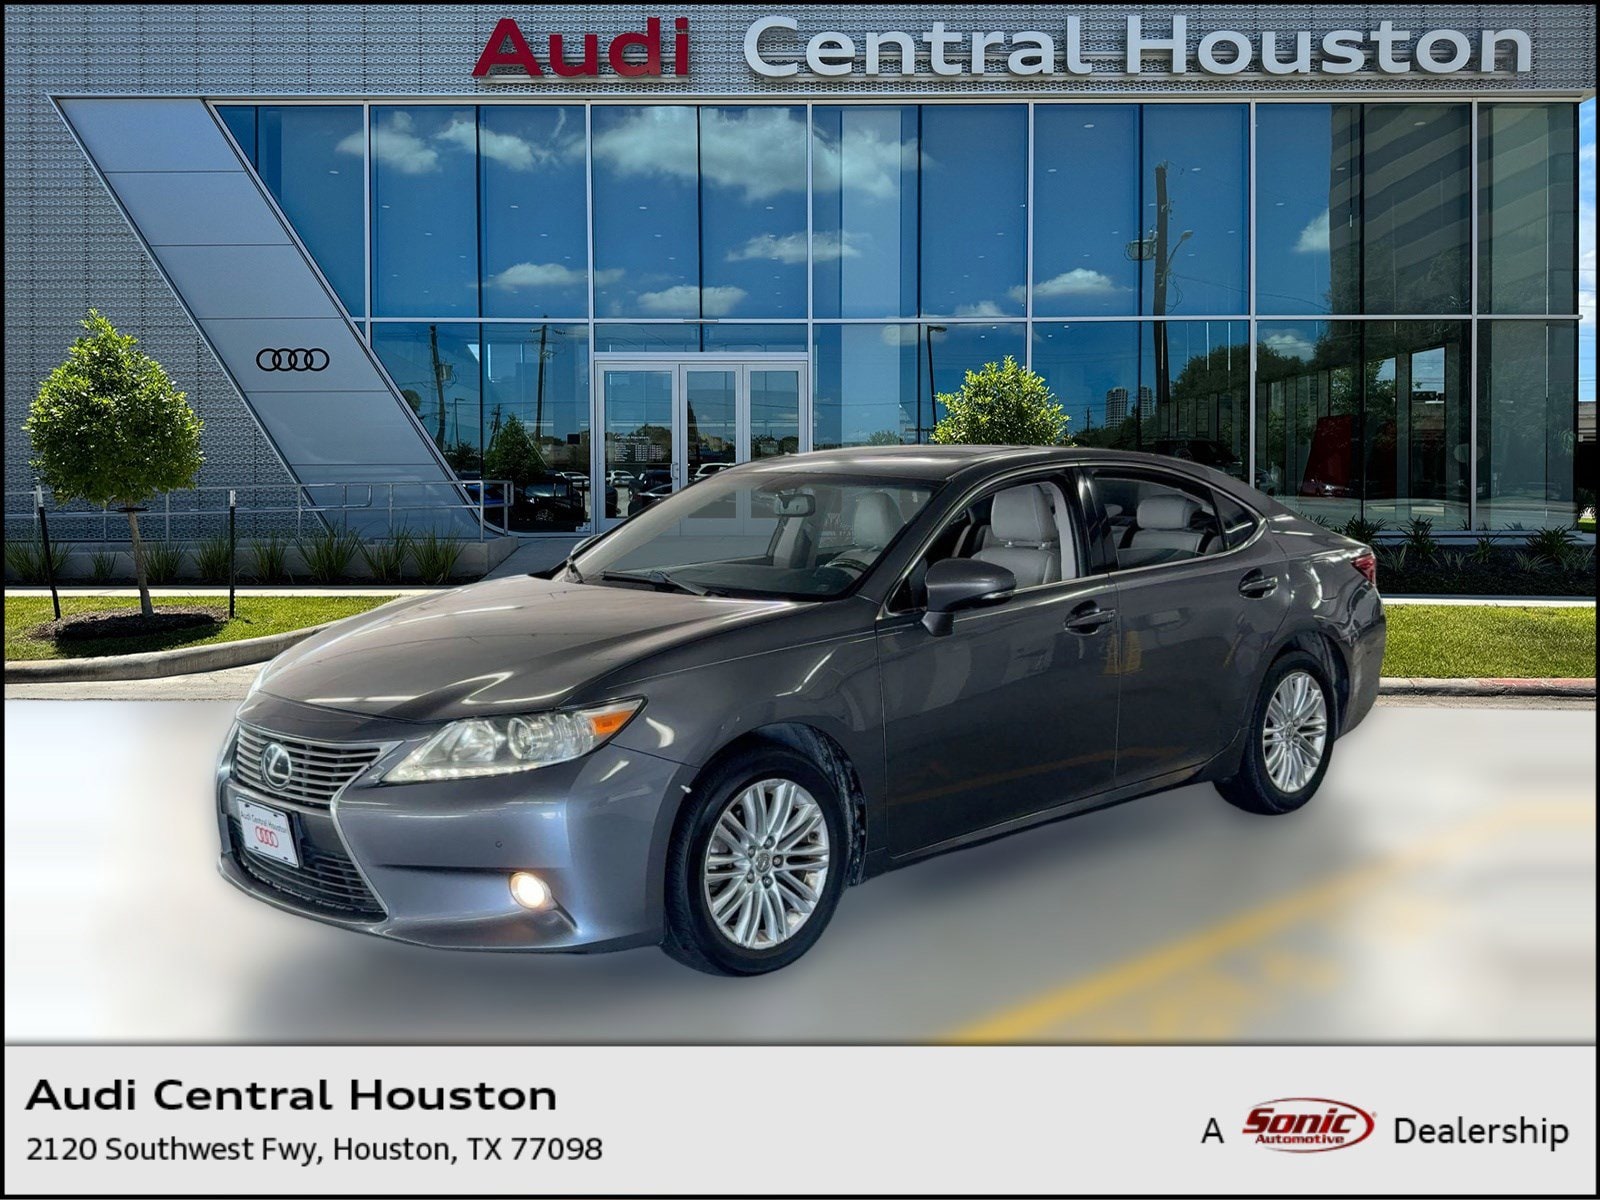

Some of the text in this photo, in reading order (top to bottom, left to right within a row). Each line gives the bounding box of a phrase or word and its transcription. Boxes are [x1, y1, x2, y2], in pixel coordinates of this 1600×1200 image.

[472, 15, 1532, 78] Audi Central Houston
